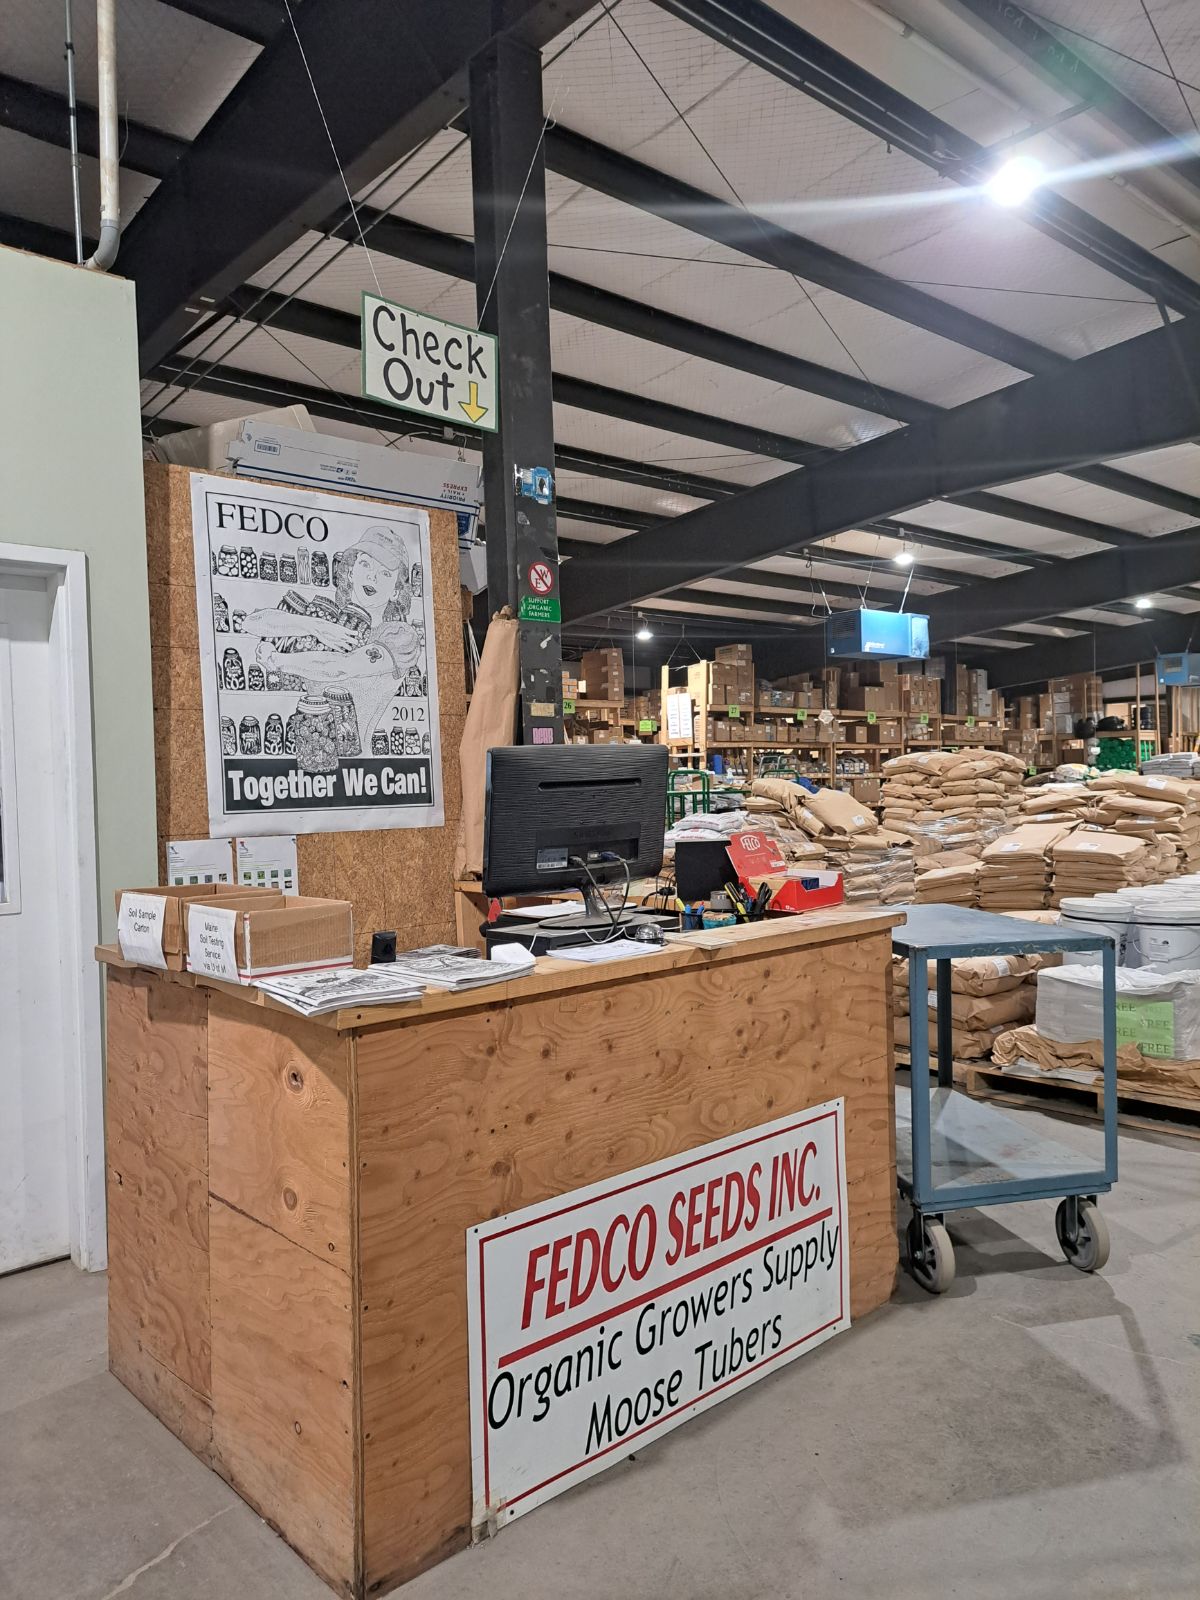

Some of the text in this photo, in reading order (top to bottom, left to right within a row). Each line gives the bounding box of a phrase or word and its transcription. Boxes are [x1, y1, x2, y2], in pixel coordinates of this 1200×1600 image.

[372, 305, 487, 379] Check
[383, 357, 454, 411] Out
[214, 501, 329, 542] FEDCO
[528, 597, 550, 605] SUPPORT
[528, 604, 553, 612] ORGANIC
[392, 706, 425, 722] 2012
[563, 701, 572, 710] 26
[228, 766, 427, 807] Together We Can!
[739, 834, 761, 851] FELCO
[128, 907, 157, 922] Soil Sample
[133, 922, 150, 933] Carton
[199, 933, 225, 950] Soil Testing
[204, 947, 221, 960] Service
[521, 1141, 821, 1331] FEDCO SEEDS INC.
[487, 1219, 840, 1431] Organic Growers Supply
[585, 1313, 782, 1456] Moose Tubers
